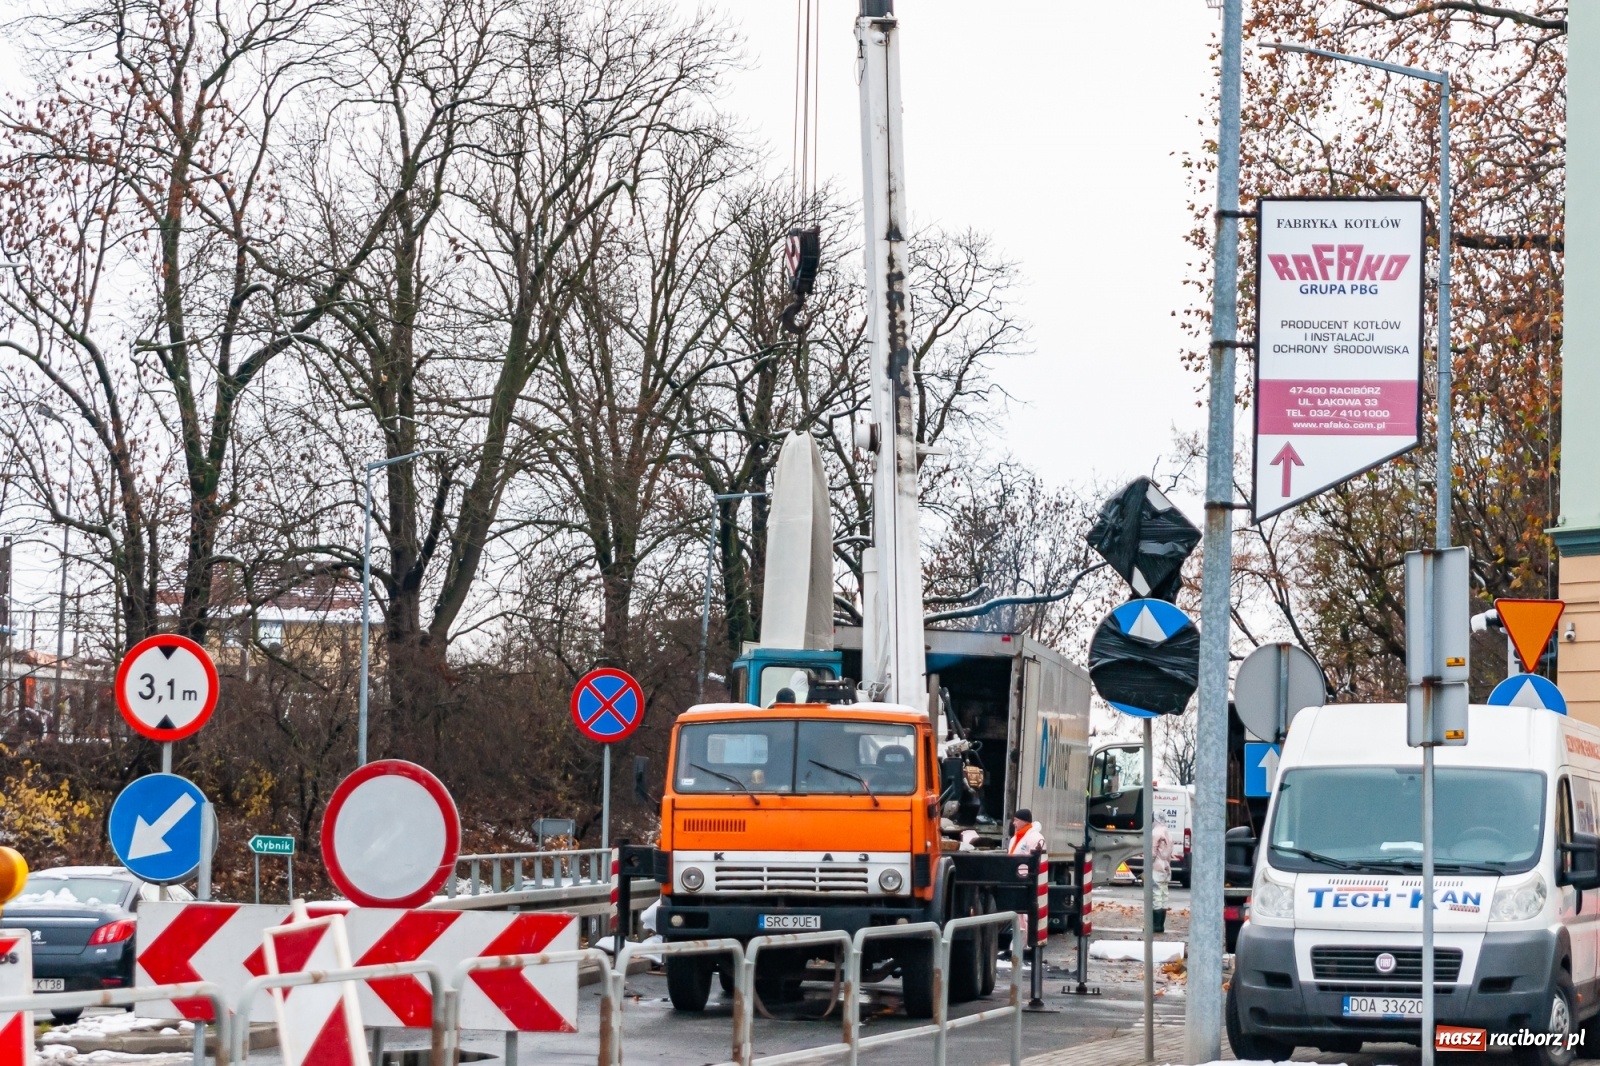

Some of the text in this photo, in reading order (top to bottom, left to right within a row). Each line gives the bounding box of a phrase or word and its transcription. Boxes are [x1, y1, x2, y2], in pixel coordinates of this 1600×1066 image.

[1276, 216, 1401, 229] FABRYKA KOTŁÓW
[1267, 244, 1411, 281] RAFAKO
[1299, 283, 1379, 295] GRUPA PBG
[1280, 319, 1401, 330] PRODUCENT KOTŁÓW
[1304, 333, 1375, 342] I INSTALACJI
[1272, 343, 1410, 355] OCHRONY ŚRODOWISKA
[1289, 385, 1381, 396] 47-400 RACIBÓRZ
[1298, 398, 1314, 406] UL.
[1317, 398, 1362, 407] ŁĄKOWA
[1286, 409, 1306, 417] TEL.
[1309, 409, 1338, 417] 032/
[1292, 421, 1386, 430] www.rafako.com.pl
[138, 673, 197, 704] 3,1 m
[256, 840, 290, 851] Rybnik
[766, 916, 818, 928] SRC 9UE1
[36, 979, 62, 990] KT38
[1350, 998, 1423, 1014] DOA 33620
